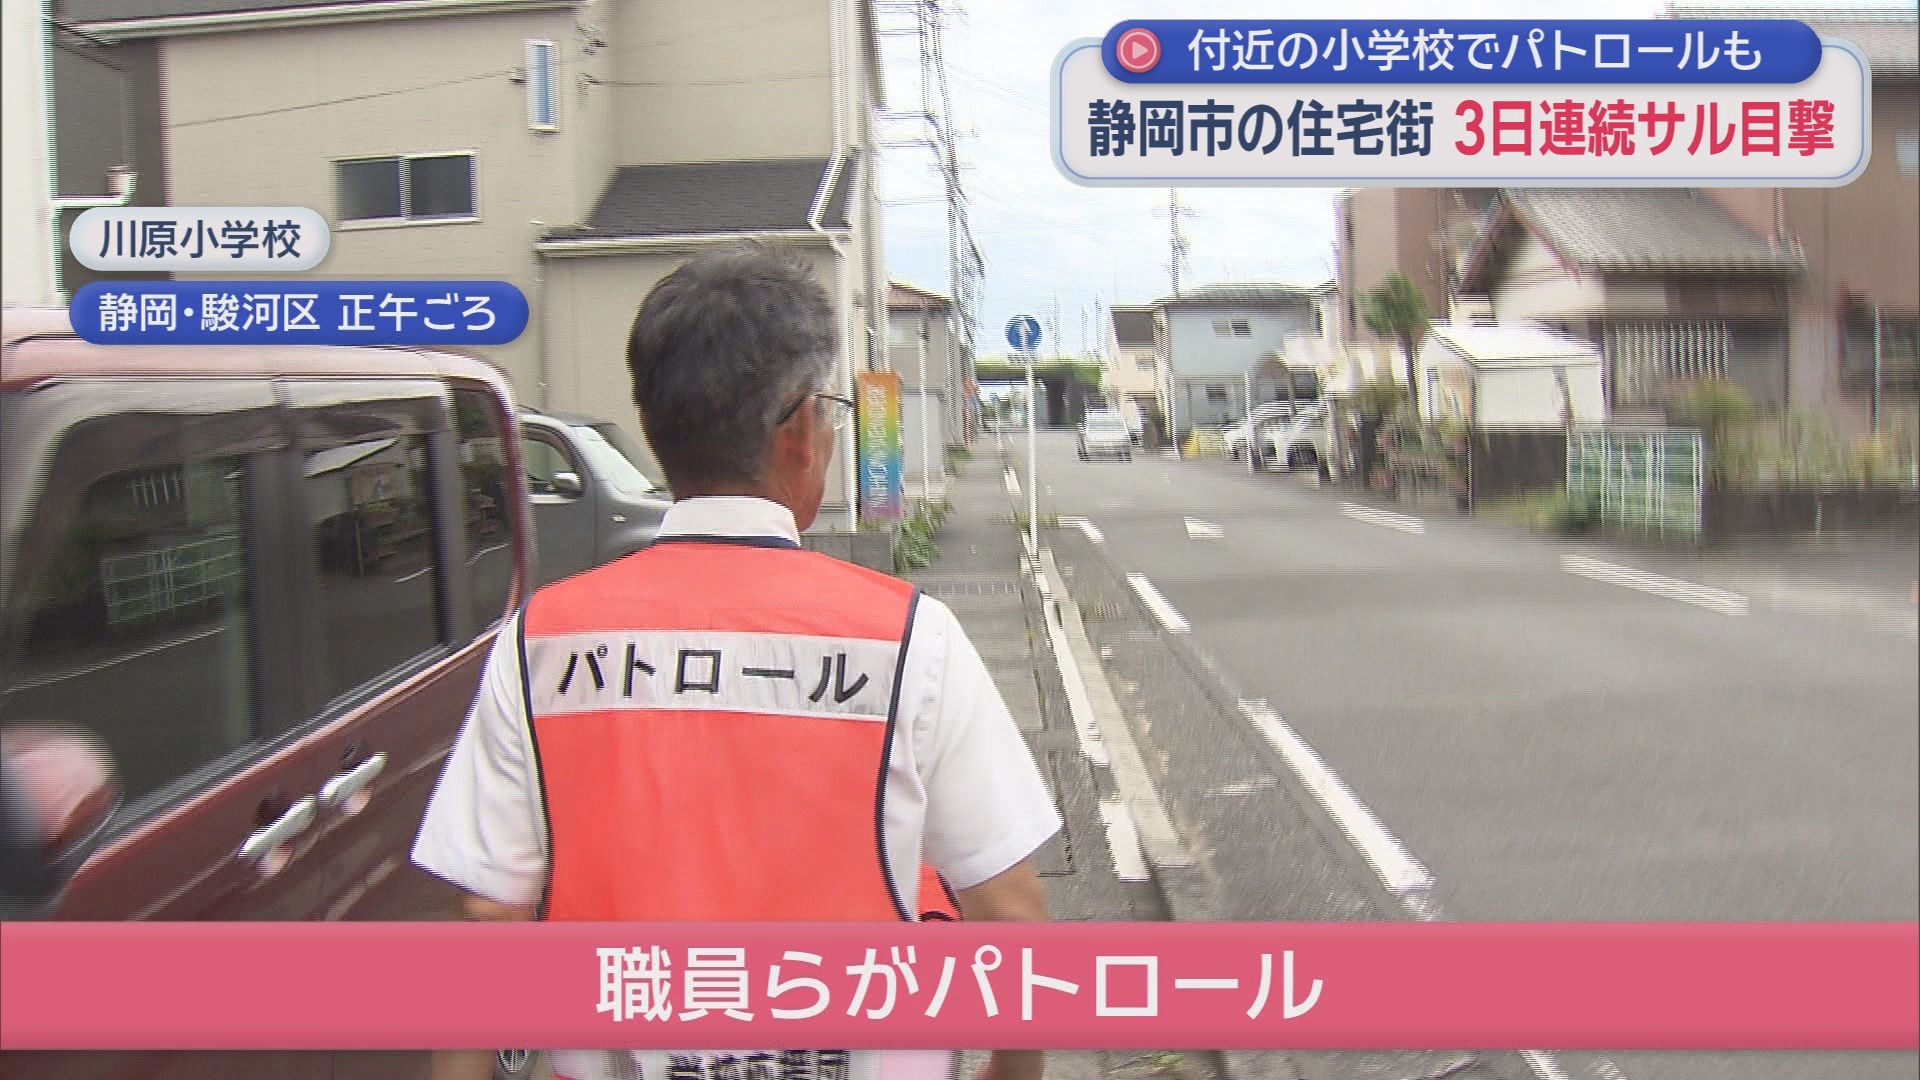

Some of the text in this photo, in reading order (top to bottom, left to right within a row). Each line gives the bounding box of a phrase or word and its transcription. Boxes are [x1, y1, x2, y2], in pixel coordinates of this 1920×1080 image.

[557, 643, 869, 704] パトロール
